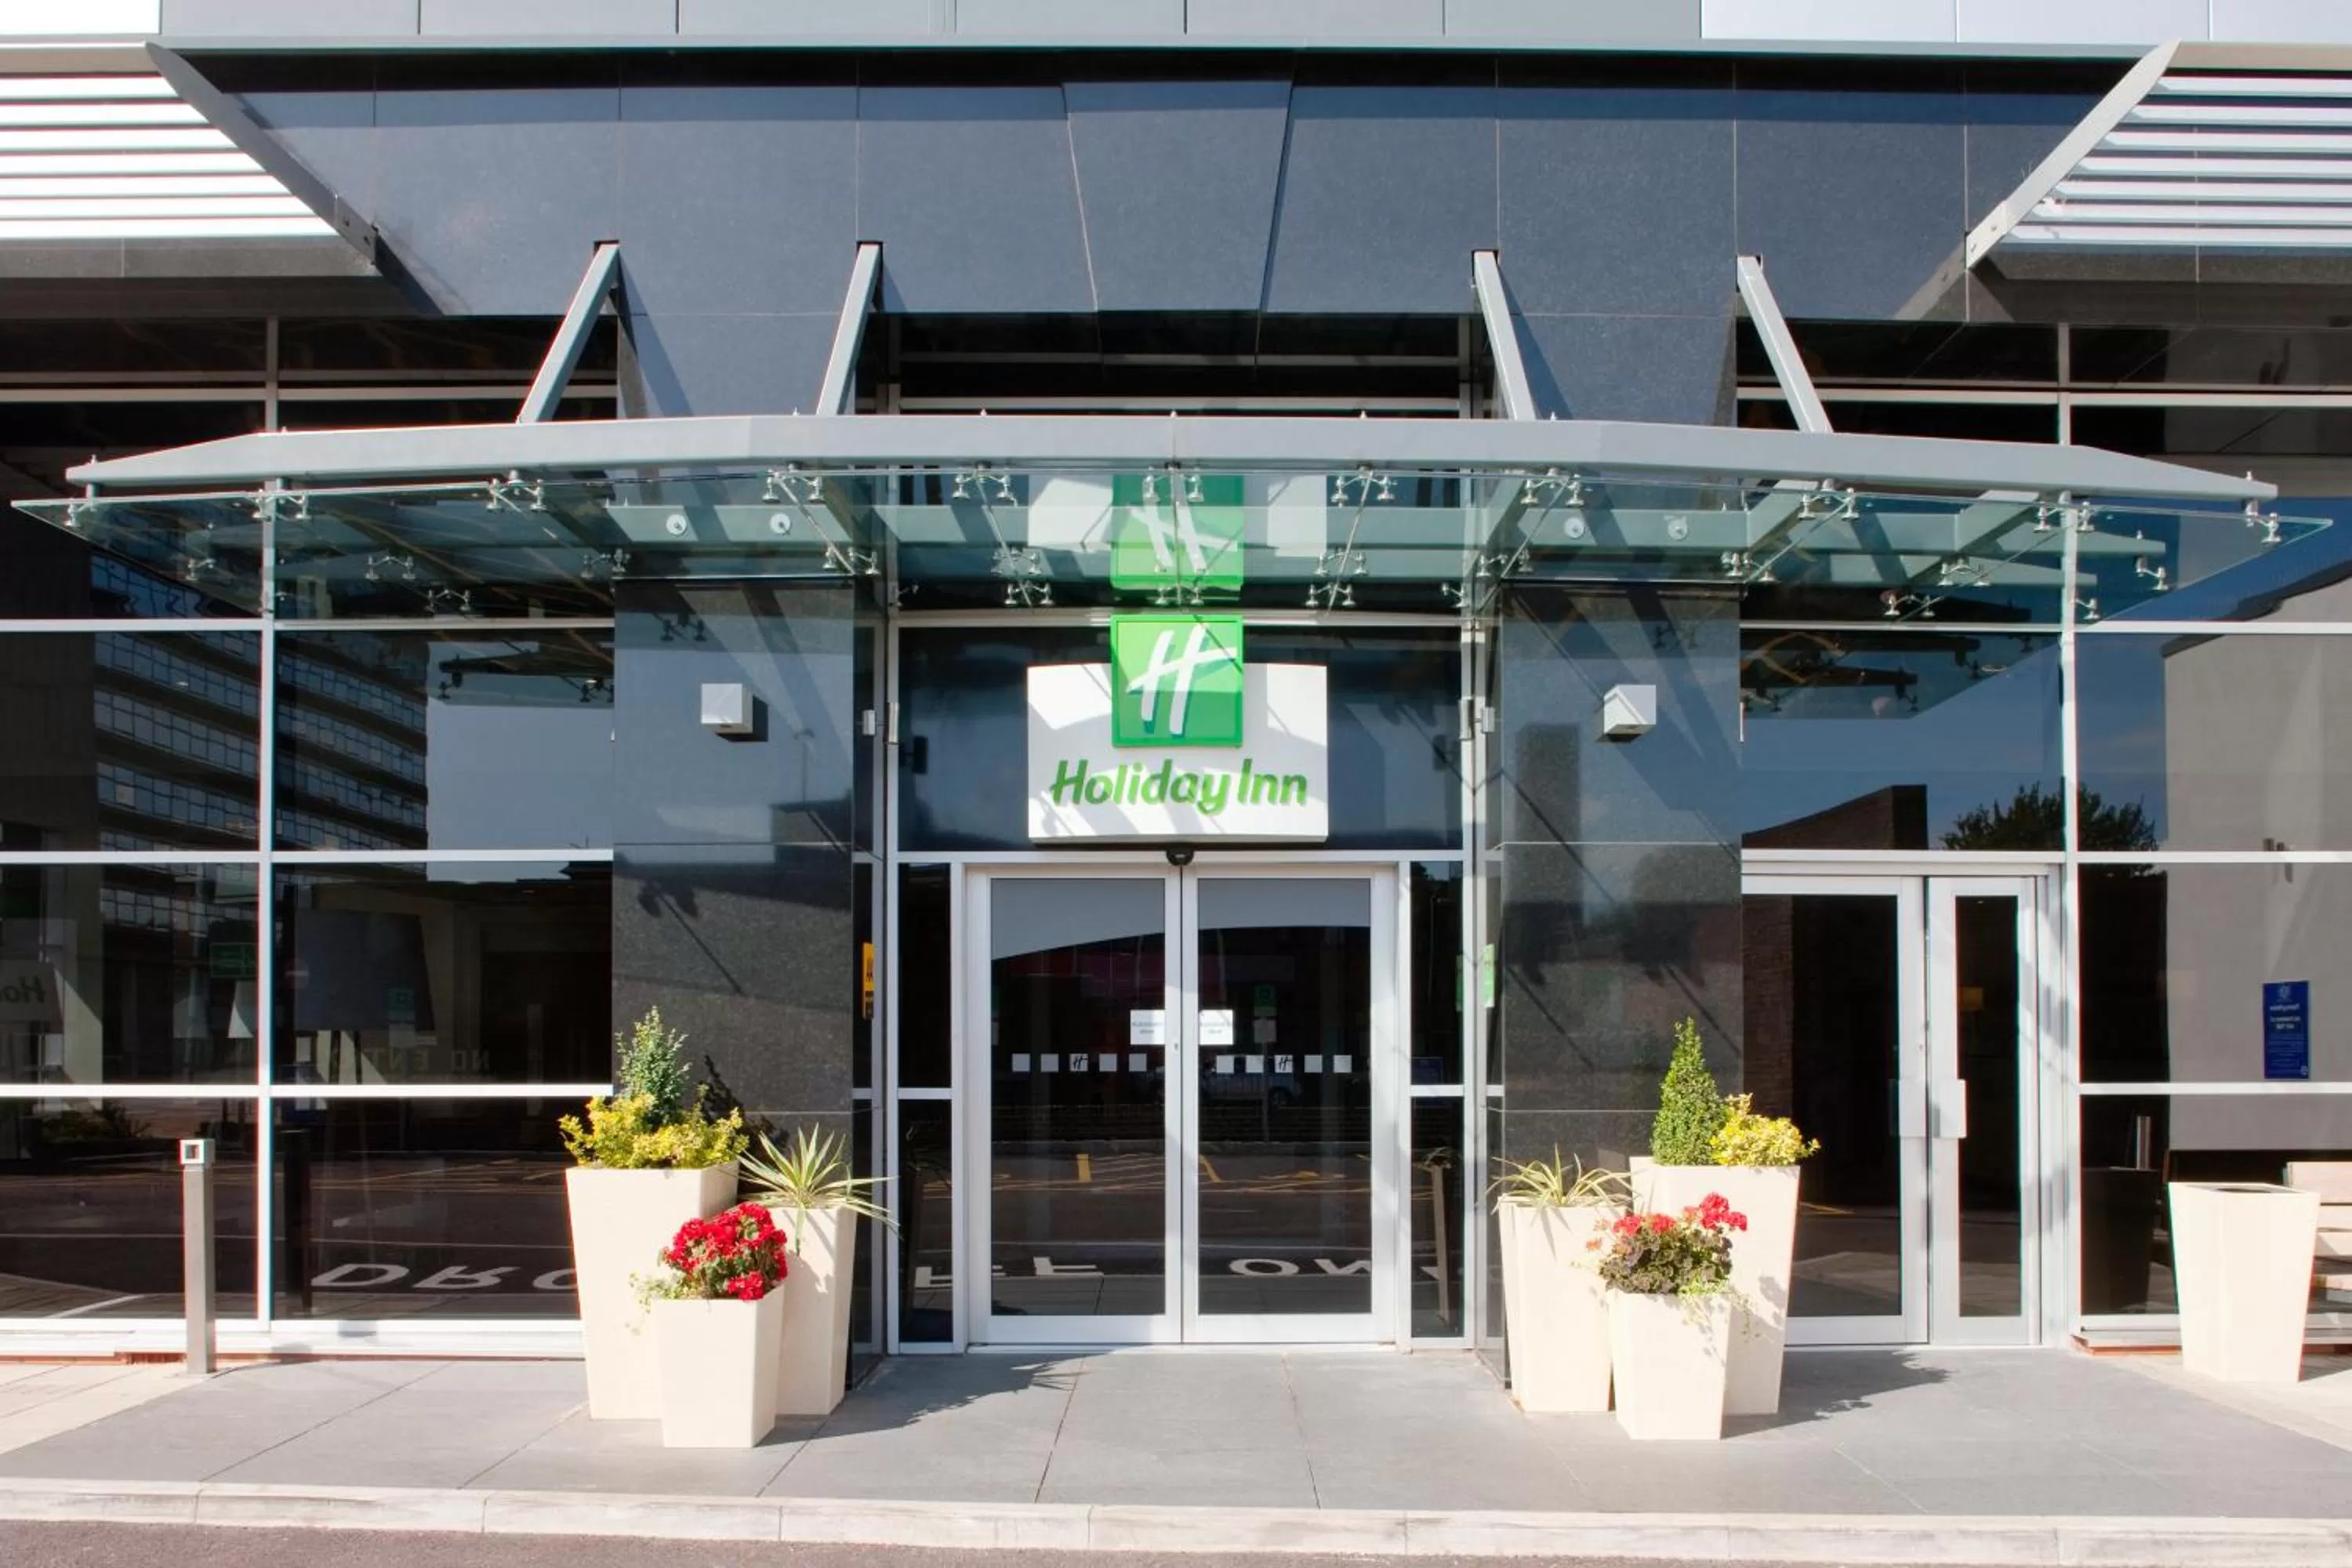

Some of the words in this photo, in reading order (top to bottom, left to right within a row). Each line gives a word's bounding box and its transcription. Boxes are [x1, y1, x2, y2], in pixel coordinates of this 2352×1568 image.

[1127, 623, 1236, 735] H
[1050, 759, 1229, 815] Holiday
[1238, 758, 1308, 805] Inn
